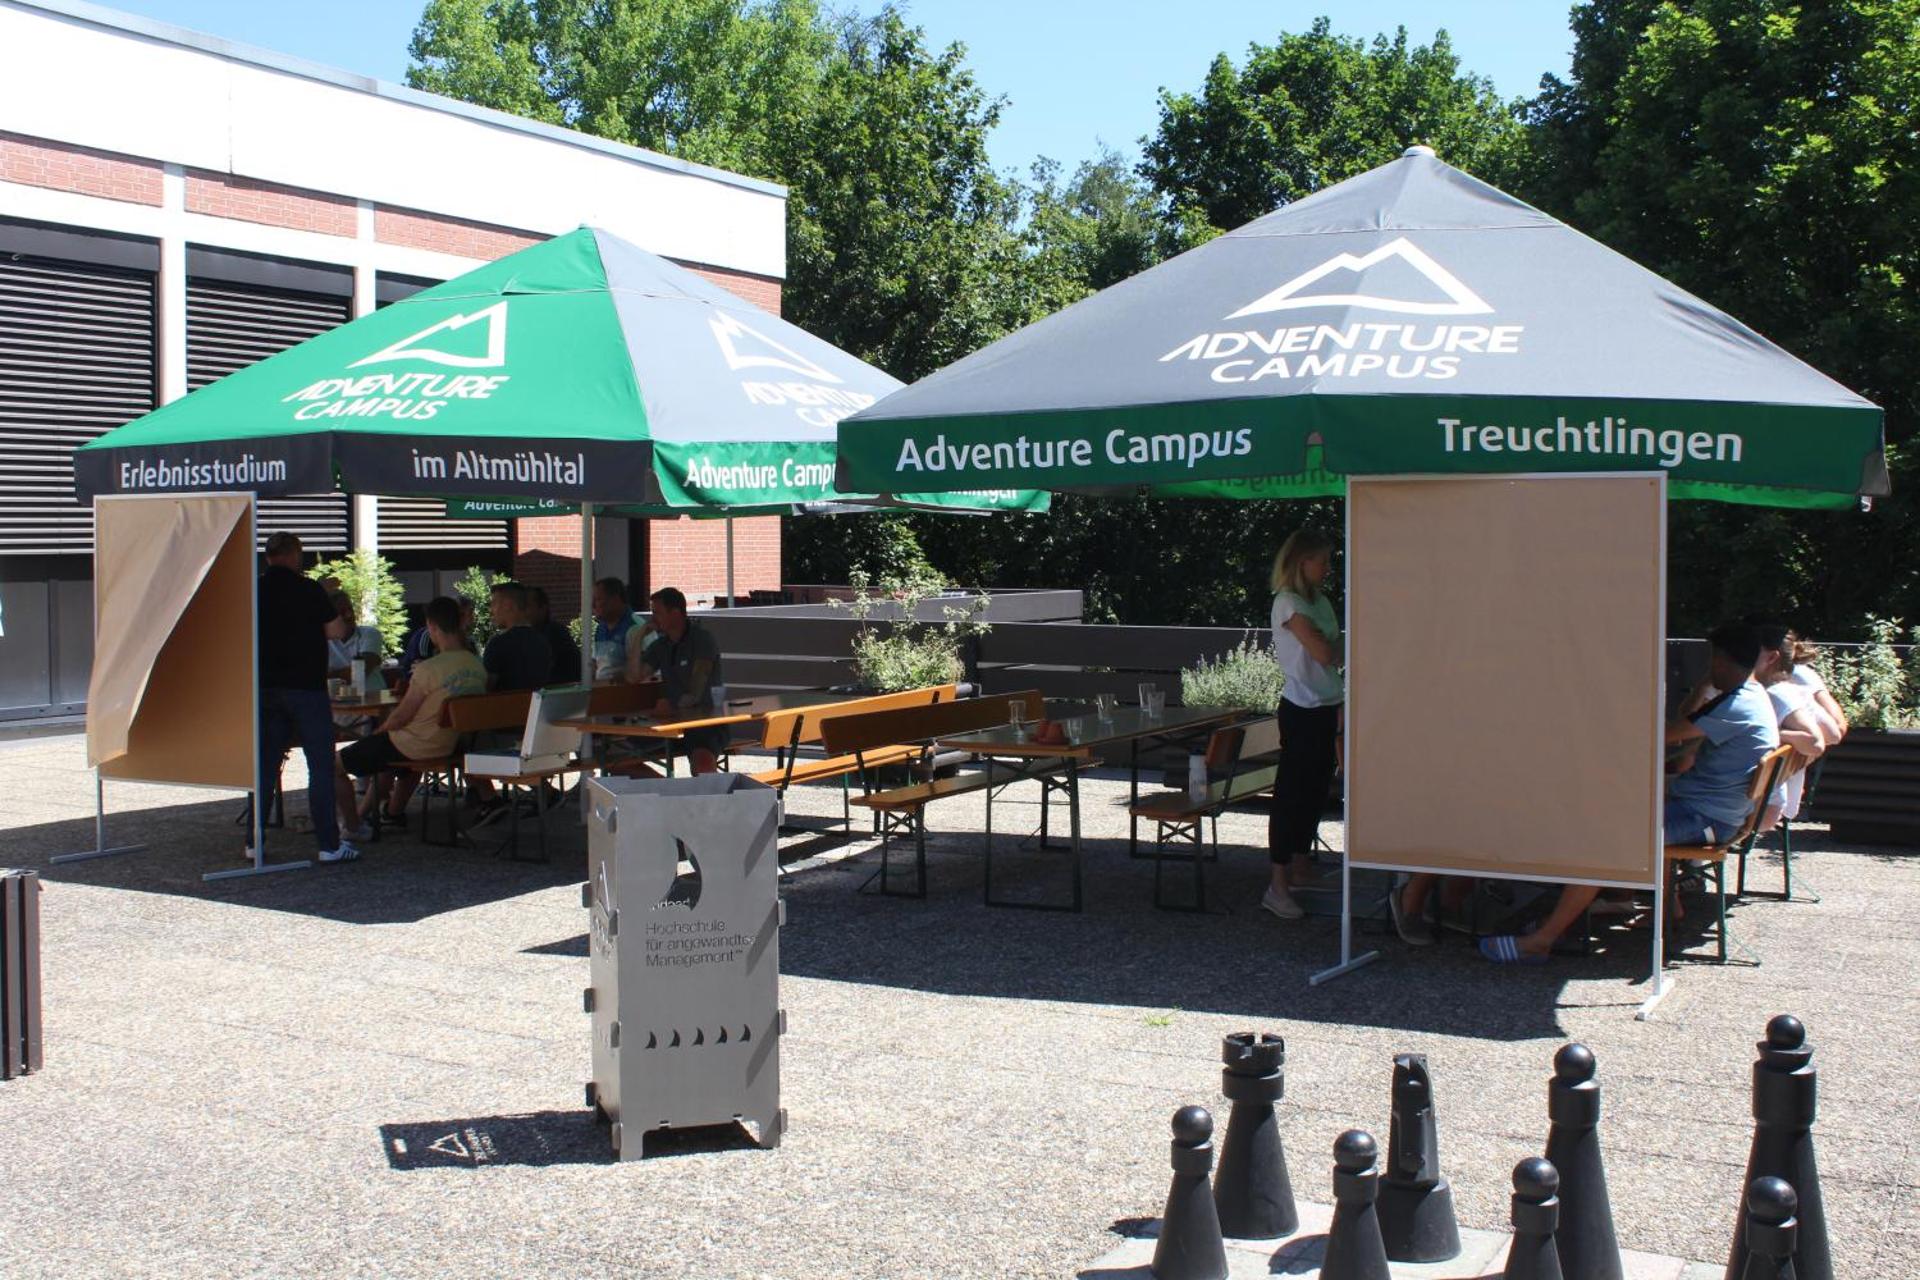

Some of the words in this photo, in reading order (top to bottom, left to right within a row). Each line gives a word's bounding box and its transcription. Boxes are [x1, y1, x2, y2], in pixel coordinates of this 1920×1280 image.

[1157, 323, 1525, 362] ADVENTURE
[1210, 353, 1462, 383] CAMPUS
[281, 372, 511, 402] ADVENTURE
[294, 397, 448, 420] CAMPUS
[895, 434, 1093, 472] Adventure
[1105, 428, 1253, 468] Campus
[1437, 416, 1743, 467] Treuchtlingen
[120, 453, 287, 488] Erlebnisstudium
[412, 448, 447, 478] im
[454, 450, 585, 485] Altmühltal
[683, 456, 778, 489] Adventure
[645, 920, 726, 935] Hochschule
[646, 938, 663, 952] für
